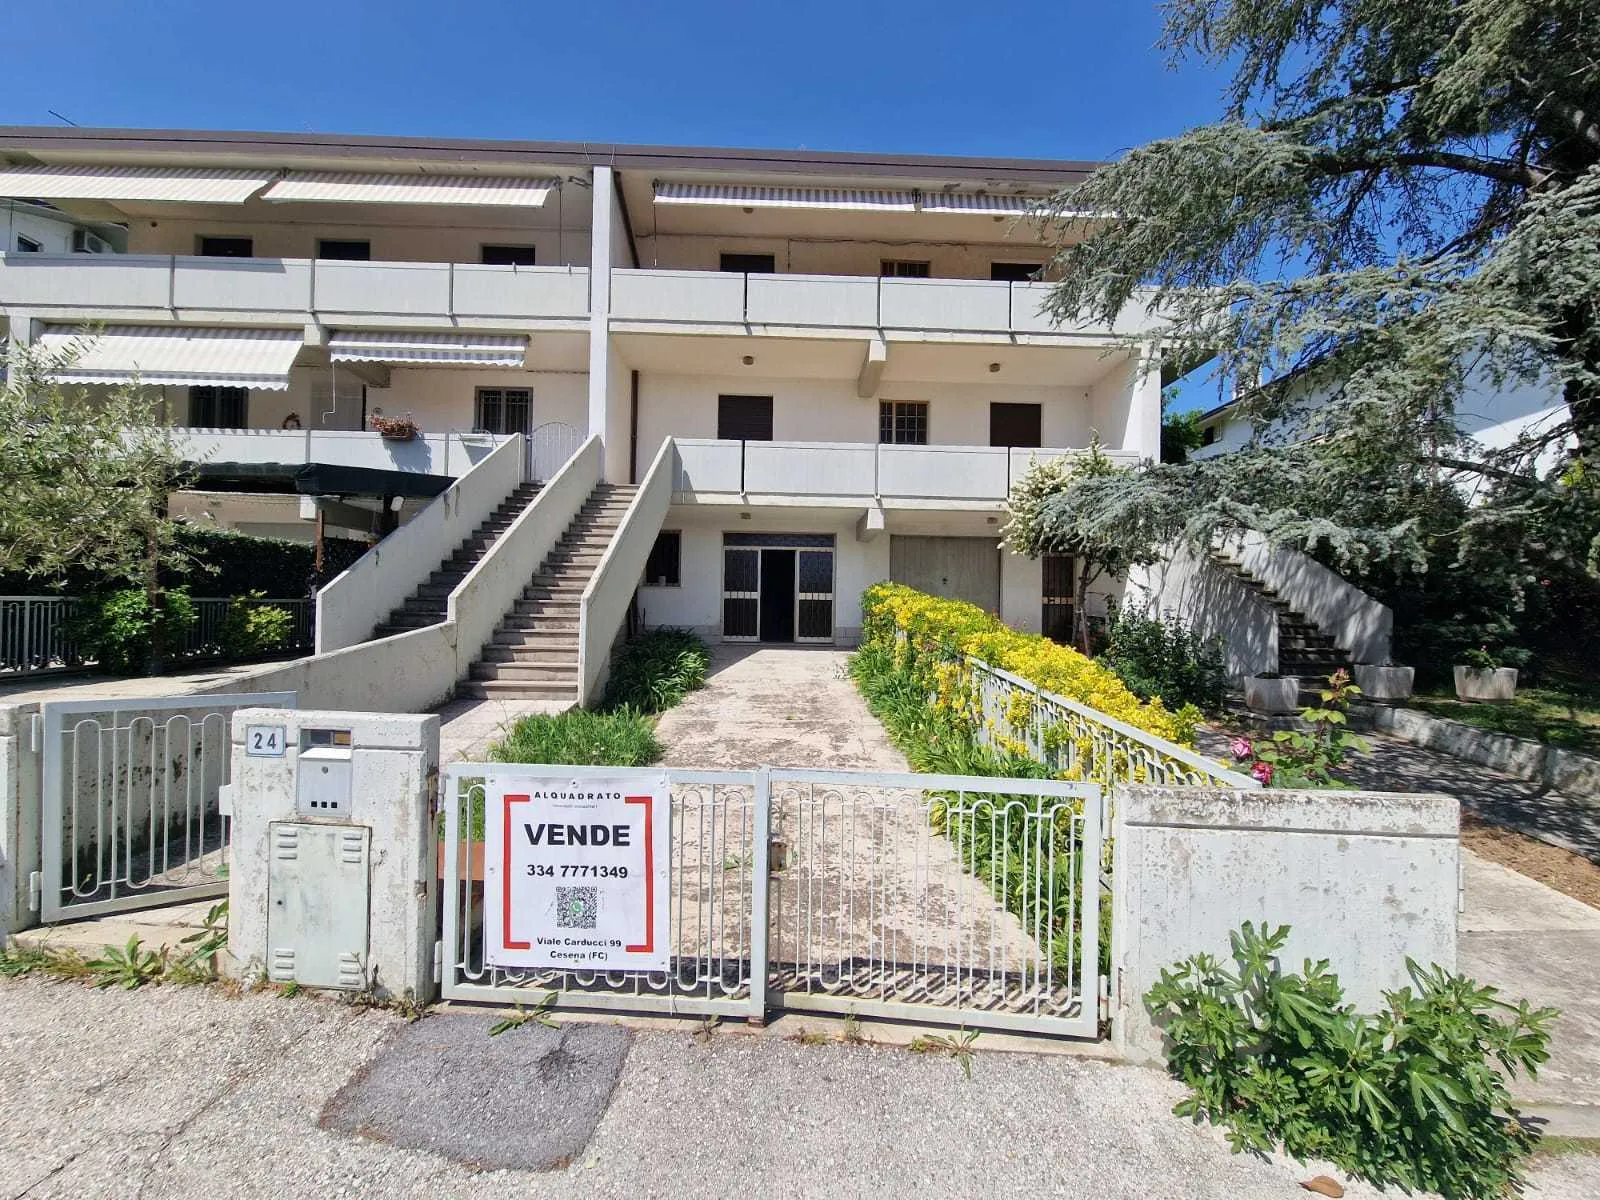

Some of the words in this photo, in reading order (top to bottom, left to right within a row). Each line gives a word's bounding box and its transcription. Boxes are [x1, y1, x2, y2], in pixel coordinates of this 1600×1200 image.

[254, 732, 277, 750] 24
[534, 791, 621, 800] ALQUADRATO
[524, 823, 631, 847] VENDE
[527, 864, 555, 877] 334
[560, 865, 628, 879] 7771349
[537, 937, 561, 946] Viale
[564, 938, 607, 947] Carducci
[550, 951, 586, 959] Cesena
[588, 952, 608, 960] (FC)
